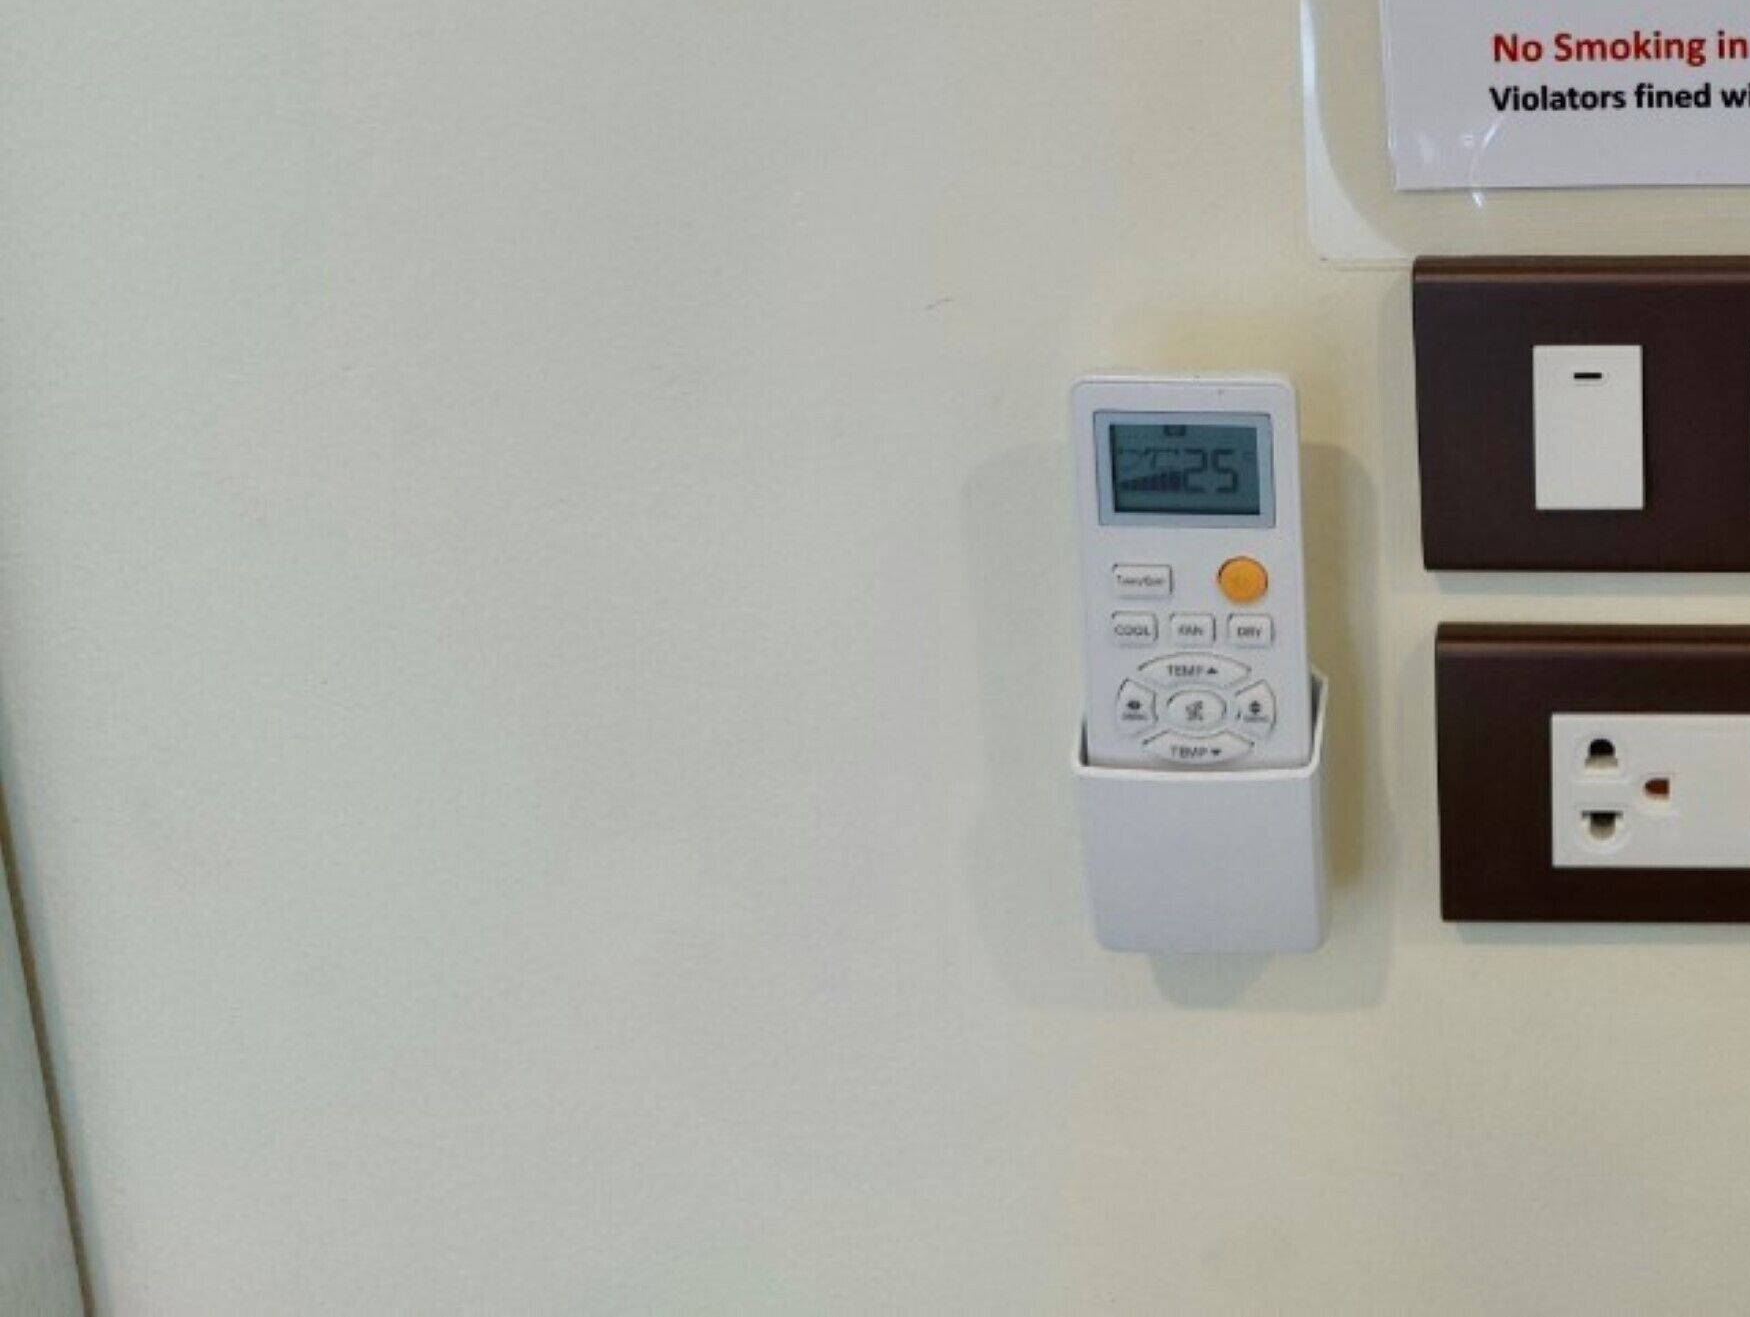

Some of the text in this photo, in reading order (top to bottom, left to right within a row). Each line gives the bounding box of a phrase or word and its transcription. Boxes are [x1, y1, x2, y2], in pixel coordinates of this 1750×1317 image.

[1493, 33, 1543, 63] No
[1554, 30, 1706, 67] Smoking
[1717, 30, 1748, 60] in
[1489, 84, 1627, 112] Violators
[1634, 82, 1712, 110] fined
[1183, 447, 1239, 494] 25
